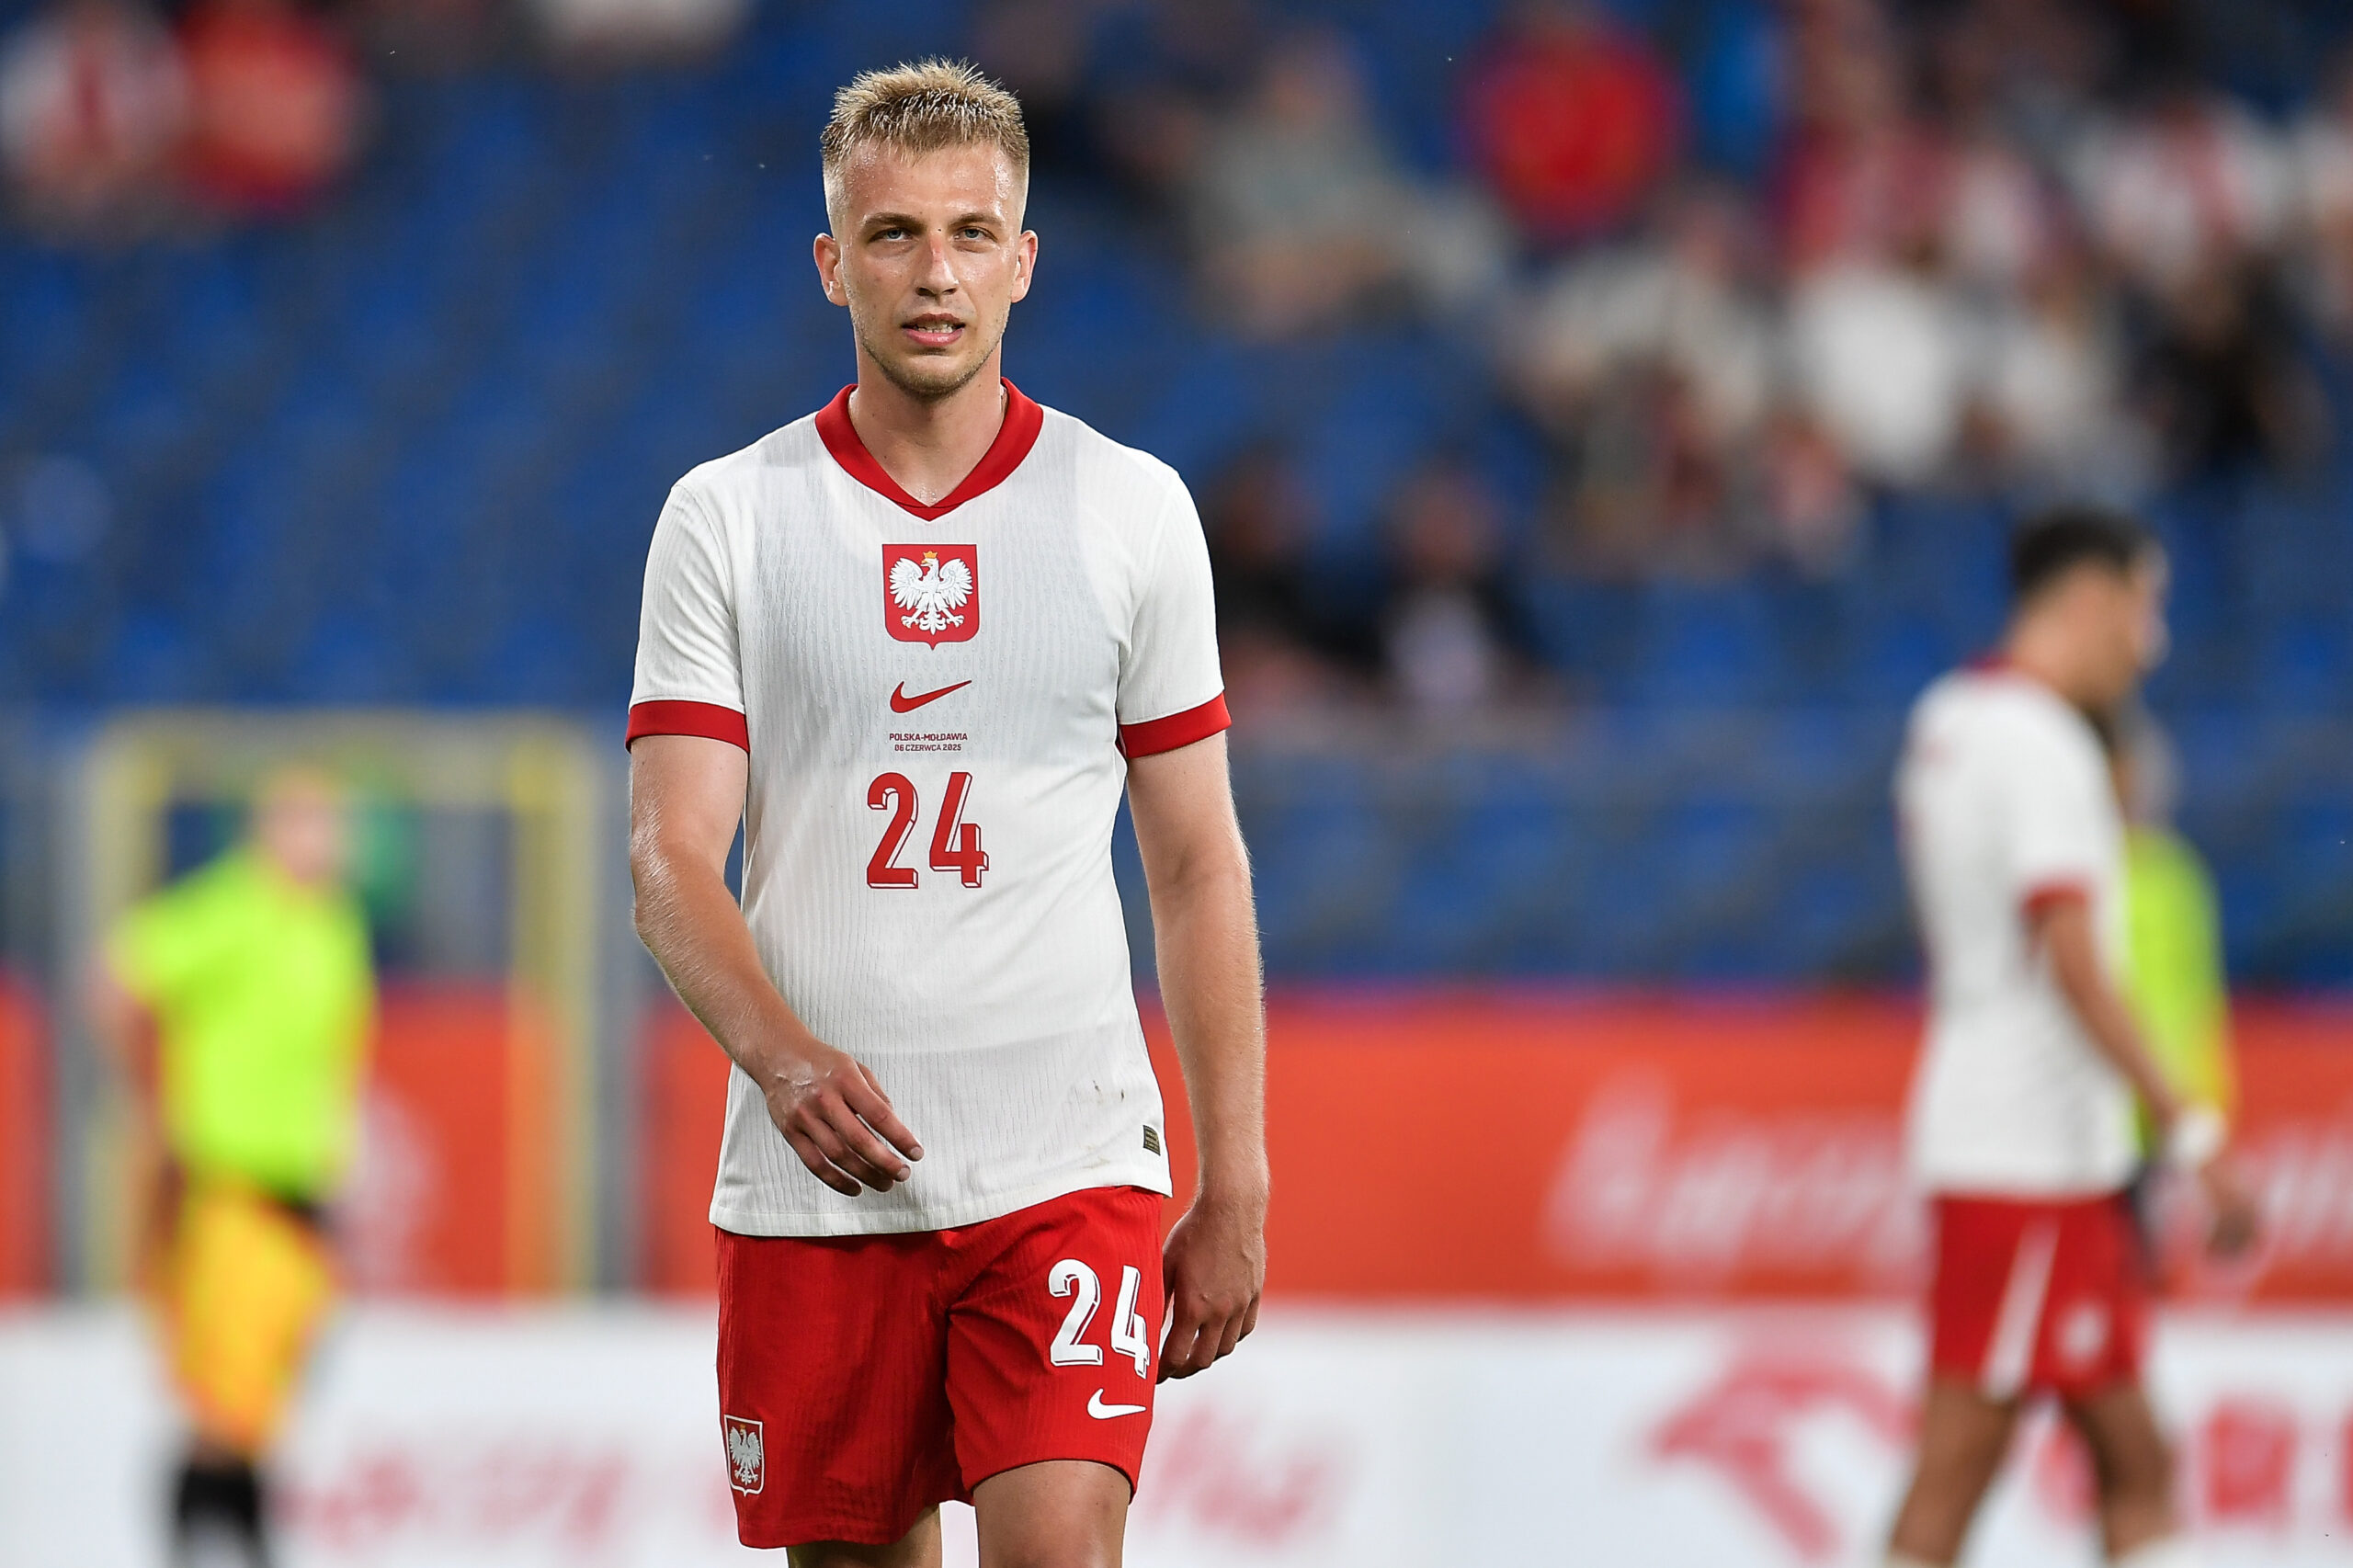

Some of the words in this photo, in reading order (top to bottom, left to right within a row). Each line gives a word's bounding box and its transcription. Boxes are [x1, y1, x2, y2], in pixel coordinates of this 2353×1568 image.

[889, 733, 968, 741] POLSKA-MOŁDAWIA
[894, 744, 904, 752] 06
[905, 744, 942, 752] CZERWCA
[867, 771, 990, 890] 24
[1048, 1258, 1151, 1380] 24
